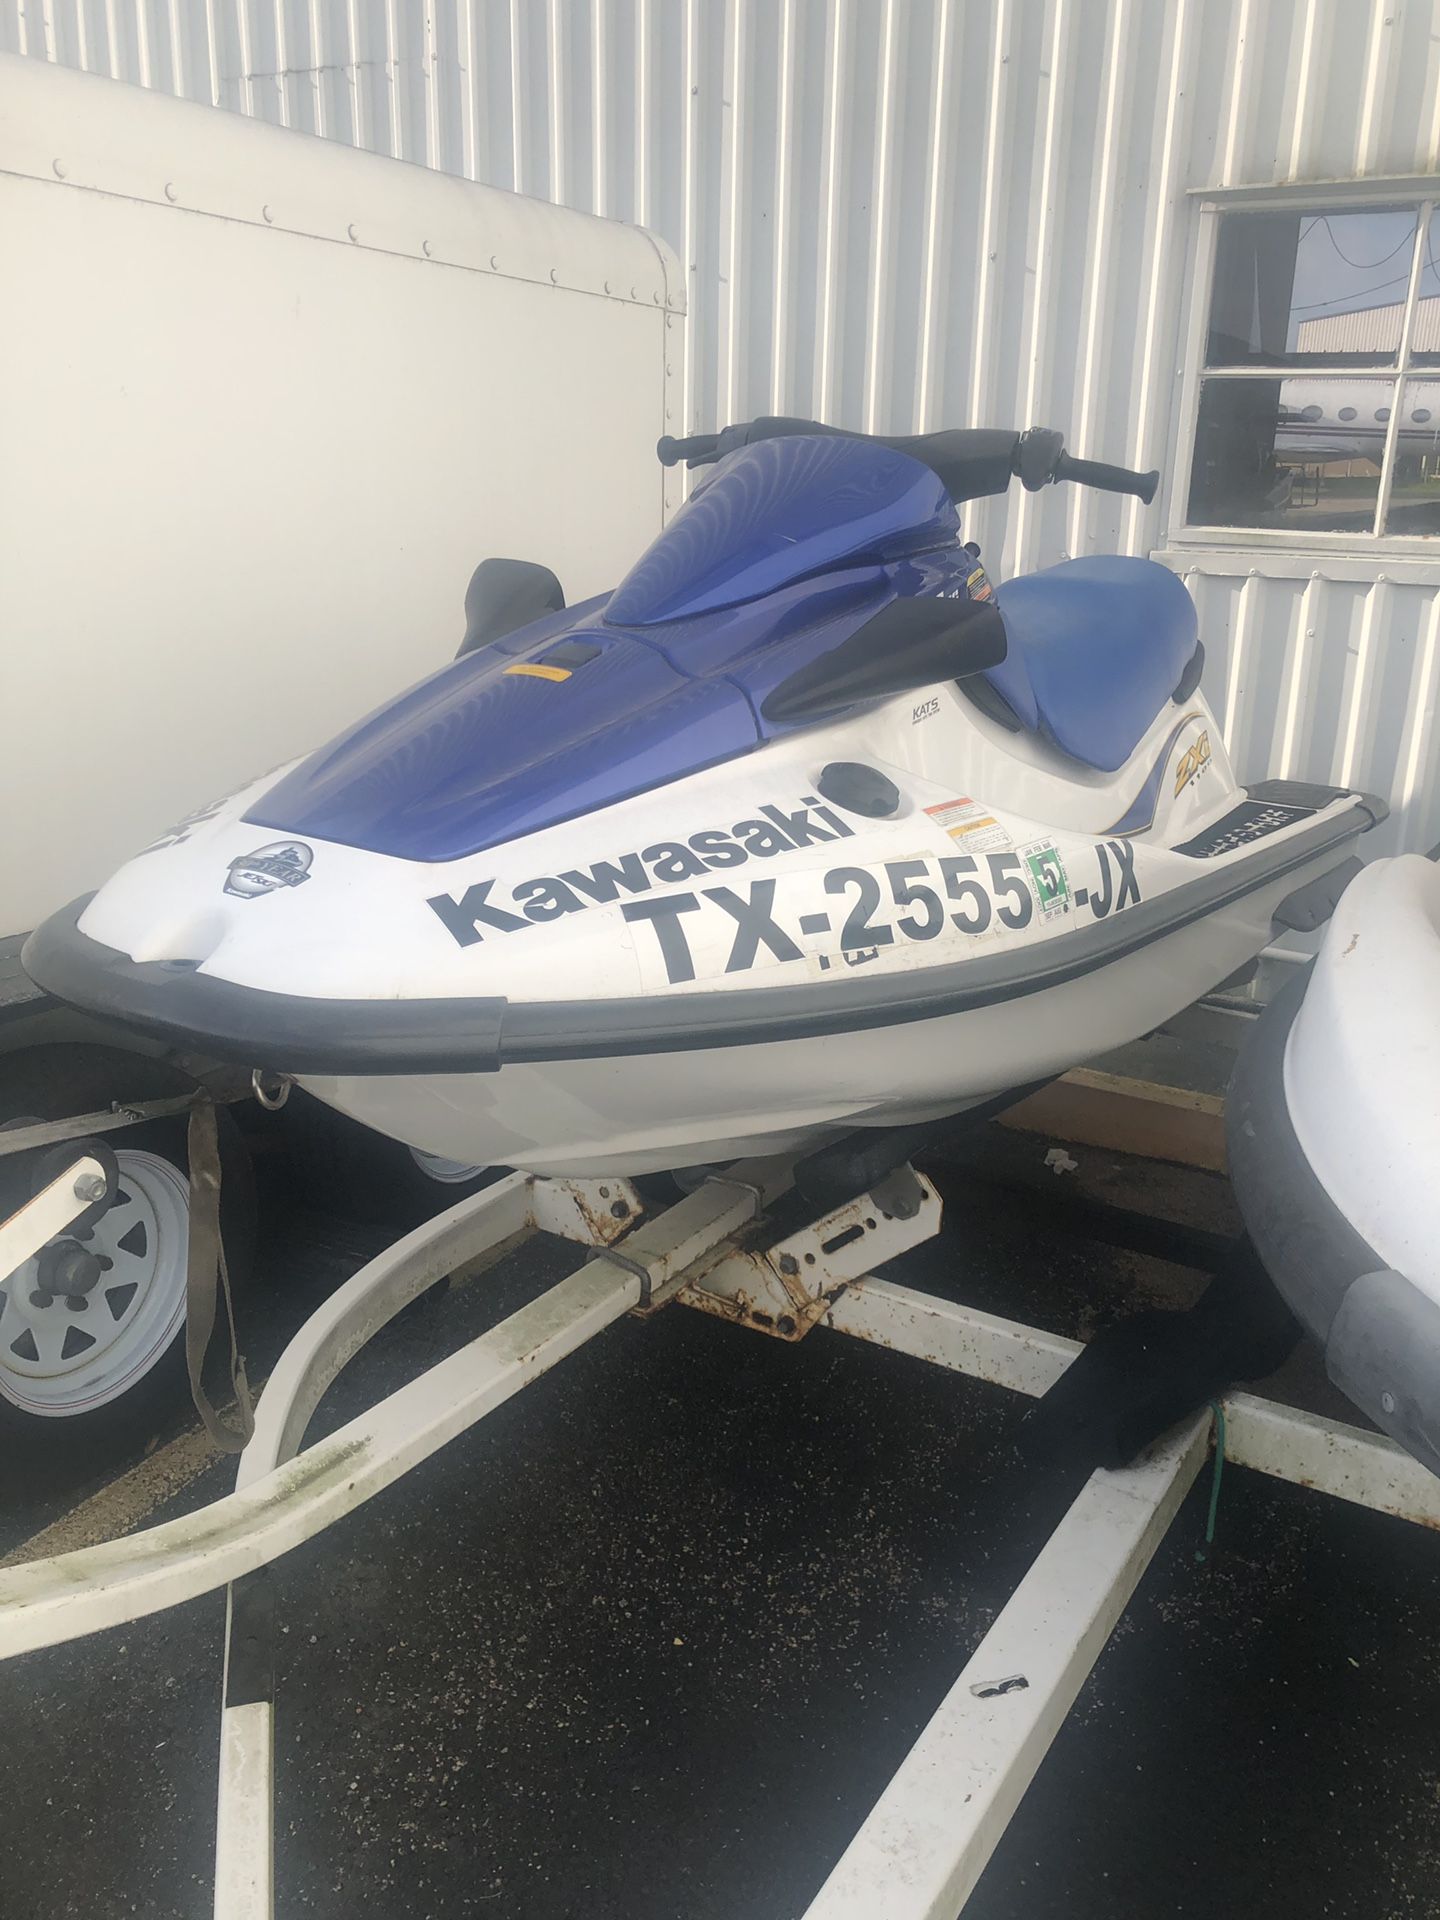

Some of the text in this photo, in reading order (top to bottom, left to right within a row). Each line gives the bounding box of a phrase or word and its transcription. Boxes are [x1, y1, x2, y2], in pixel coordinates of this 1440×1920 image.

[912, 697, 939, 720] KATS
[425, 796, 856, 947] Kawasaki
[619, 852, 1033, 984] TX-2555
[1074, 839, 1142, 919] -JX
[1037, 855, 1059, 897] 5
